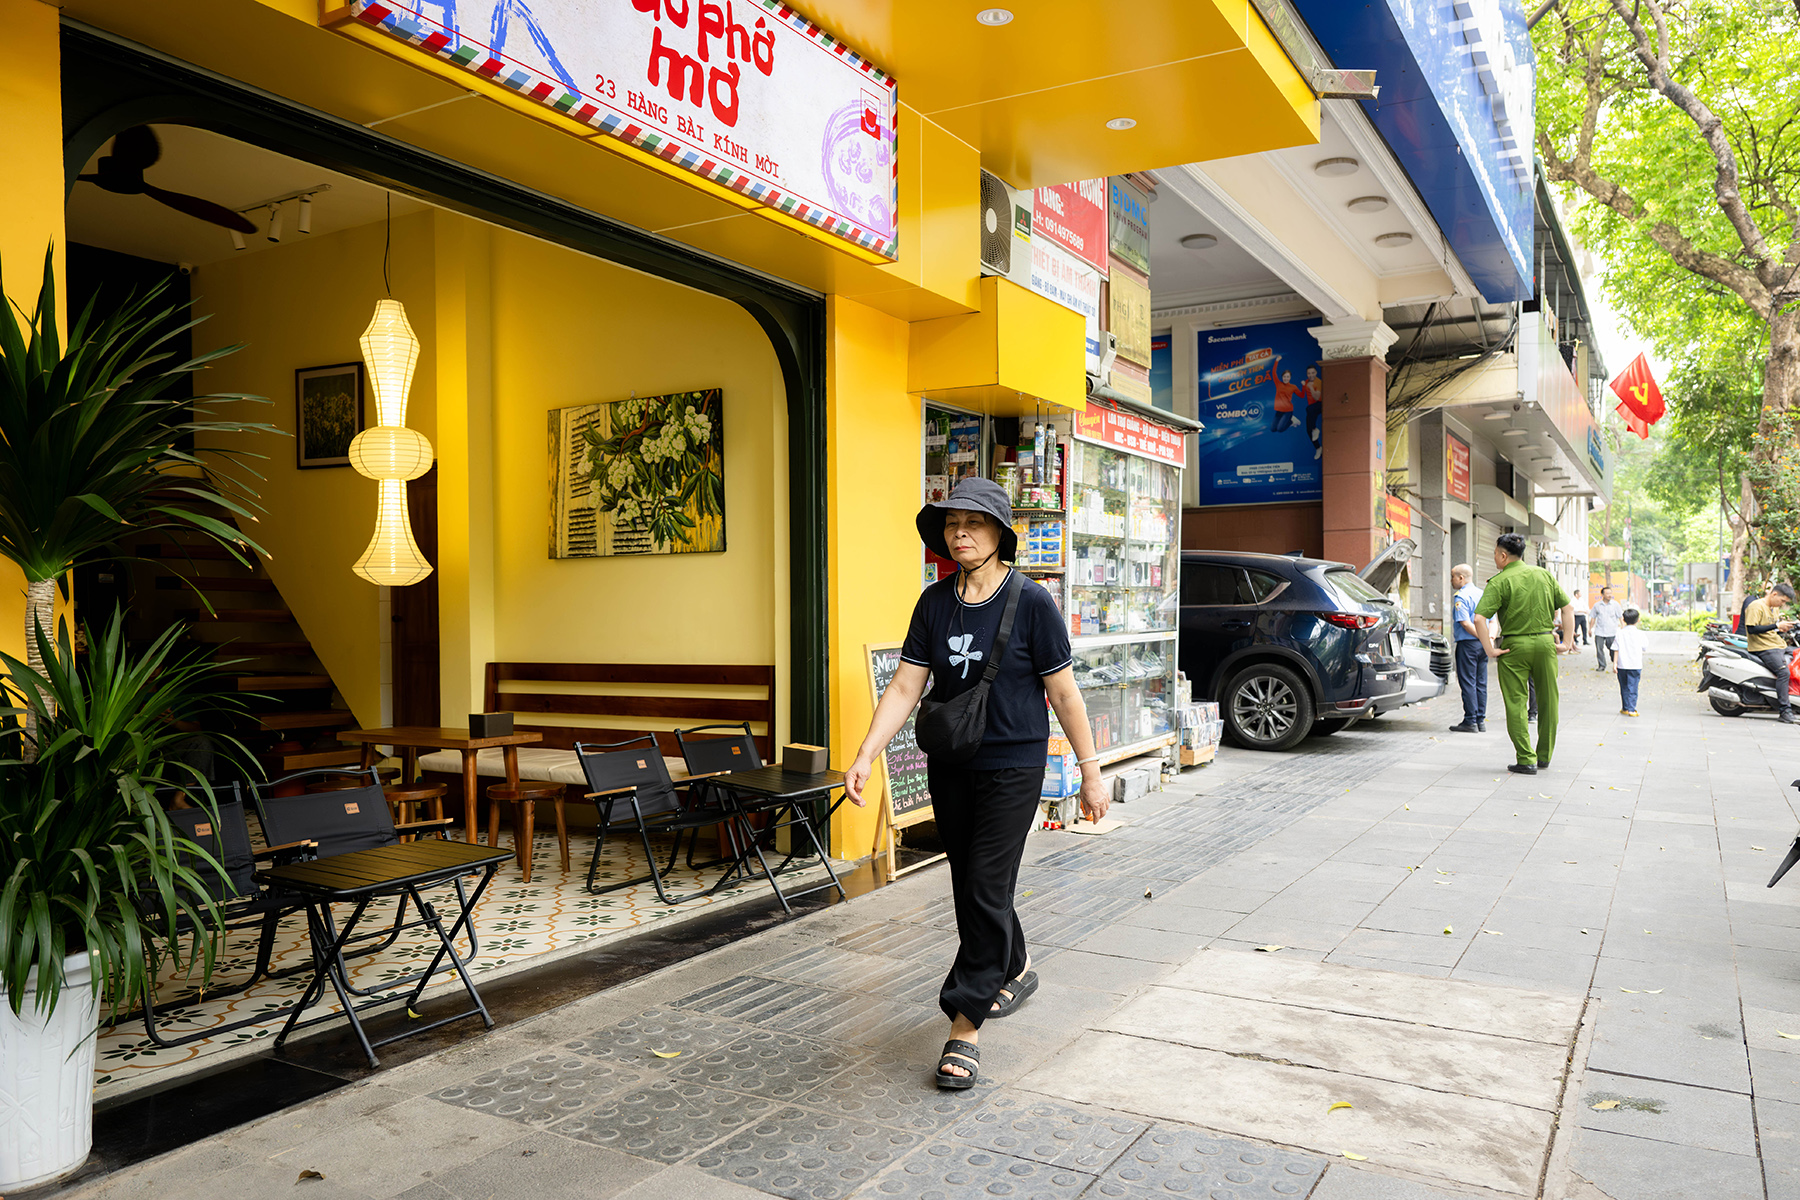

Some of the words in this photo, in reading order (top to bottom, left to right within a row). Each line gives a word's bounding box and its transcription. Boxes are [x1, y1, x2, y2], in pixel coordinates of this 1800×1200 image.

[647, 26, 741, 128] mơ
[595, 73, 617, 99] 23
[627, 90, 668, 124] HÀNG
[677, 115, 704, 142] BÀI
[713, 133, 748, 164] KÍNH
[755, 154, 779, 179] MỜI
[1112, 184, 1148, 227] BIDMC
[1208, 333, 1247, 344] Sacombank
[1228, 377, 1252, 391] CỰC
[1216, 409, 1248, 419] COMBO
